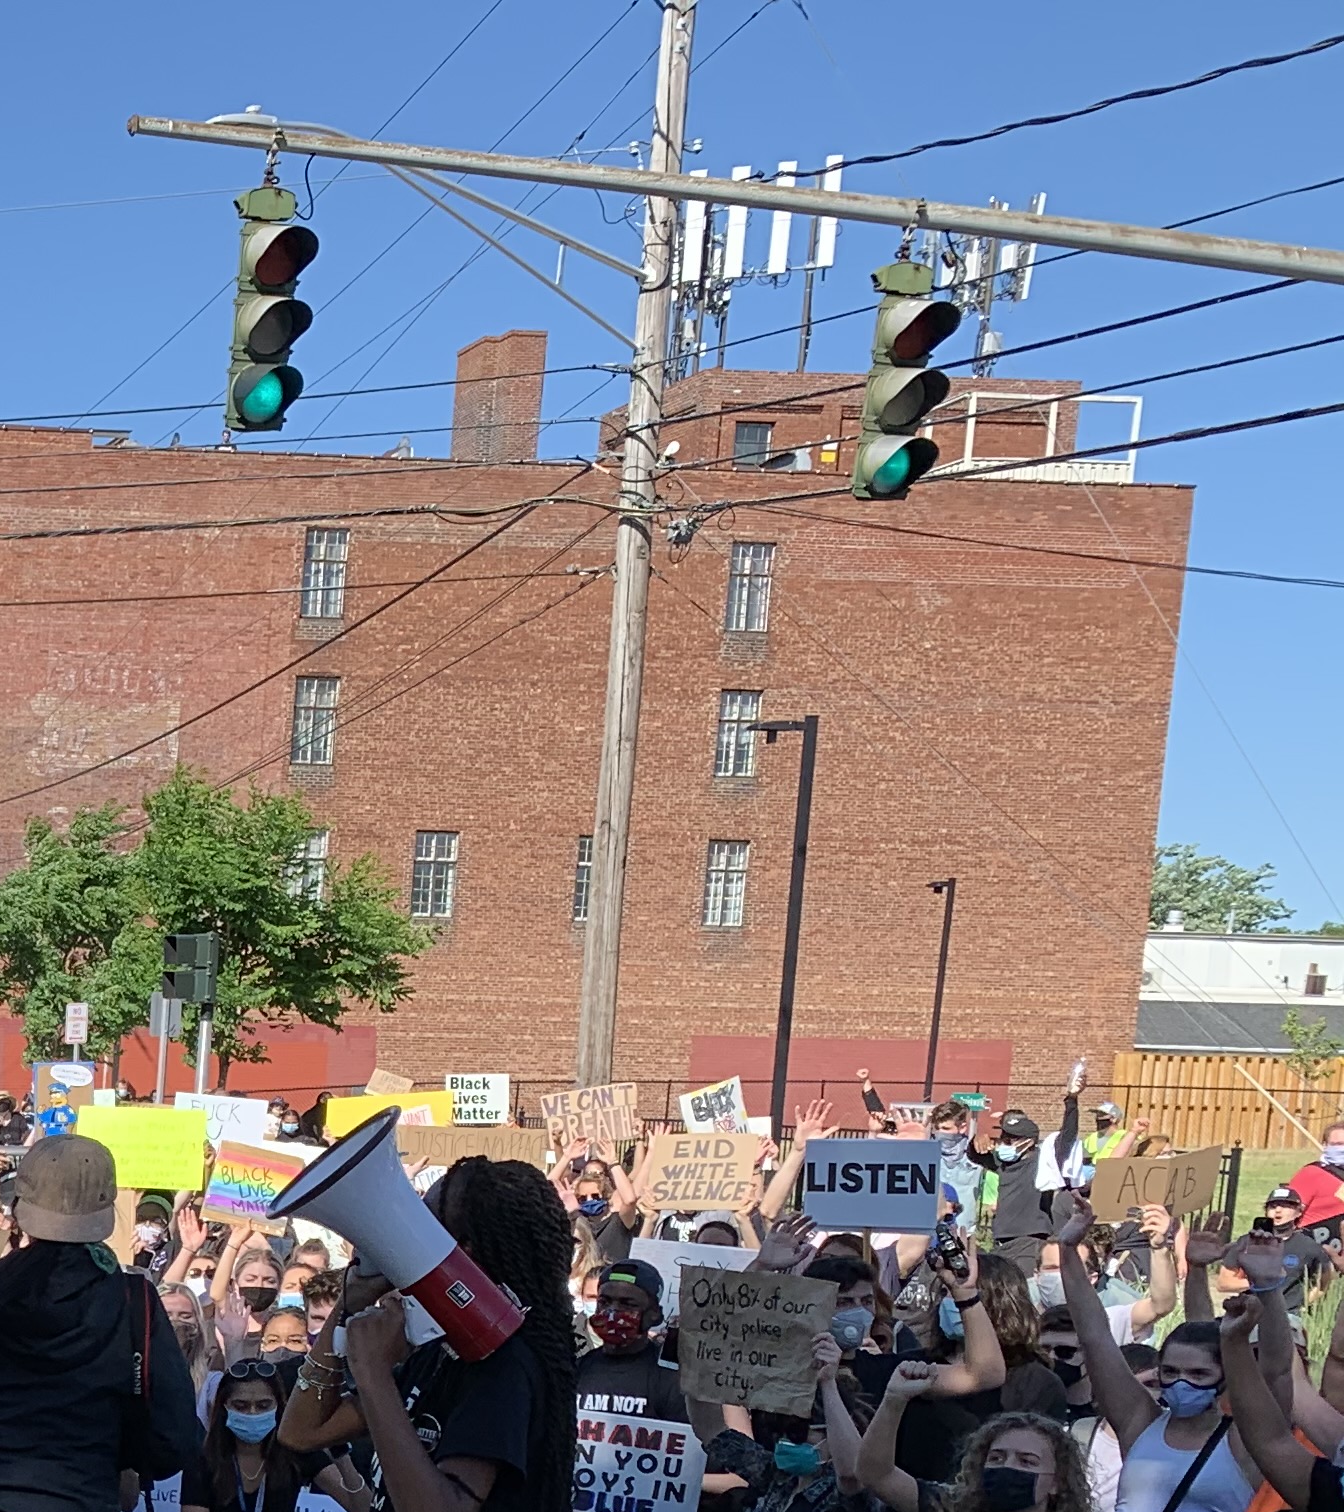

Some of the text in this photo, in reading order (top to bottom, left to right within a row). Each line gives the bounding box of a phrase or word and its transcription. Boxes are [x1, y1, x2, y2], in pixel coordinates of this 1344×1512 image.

[450, 1076, 491, 1091] Black
[452, 1092, 488, 1105] Lives
[542, 1085, 634, 1117] WE CAN'T
[451, 1107, 501, 1121] Matter
[415, 1131, 475, 1158] JUSTICE
[673, 1139, 736, 1159] END
[221, 1165, 273, 1186] BLACK
[662, 1162, 739, 1180] WHITE
[806, 1162, 937, 1196] LISTEN
[238, 1181, 276, 1199] LIVES
[652, 1181, 751, 1202] SILENCE
[1116, 1165, 1197, 1206] ACAB
[693, 1278, 817, 1315] Only 8% of our
[700, 1315, 782, 1342] city police
[696, 1341, 778, 1367] live in our
[715, 1367, 754, 1400] city.
[584, 1394, 648, 1414] AM NOT
[577, 1419, 687, 1456] HAME
[614, 1450, 683, 1478] YOU
[574, 1468, 687, 1503] OYS IN
